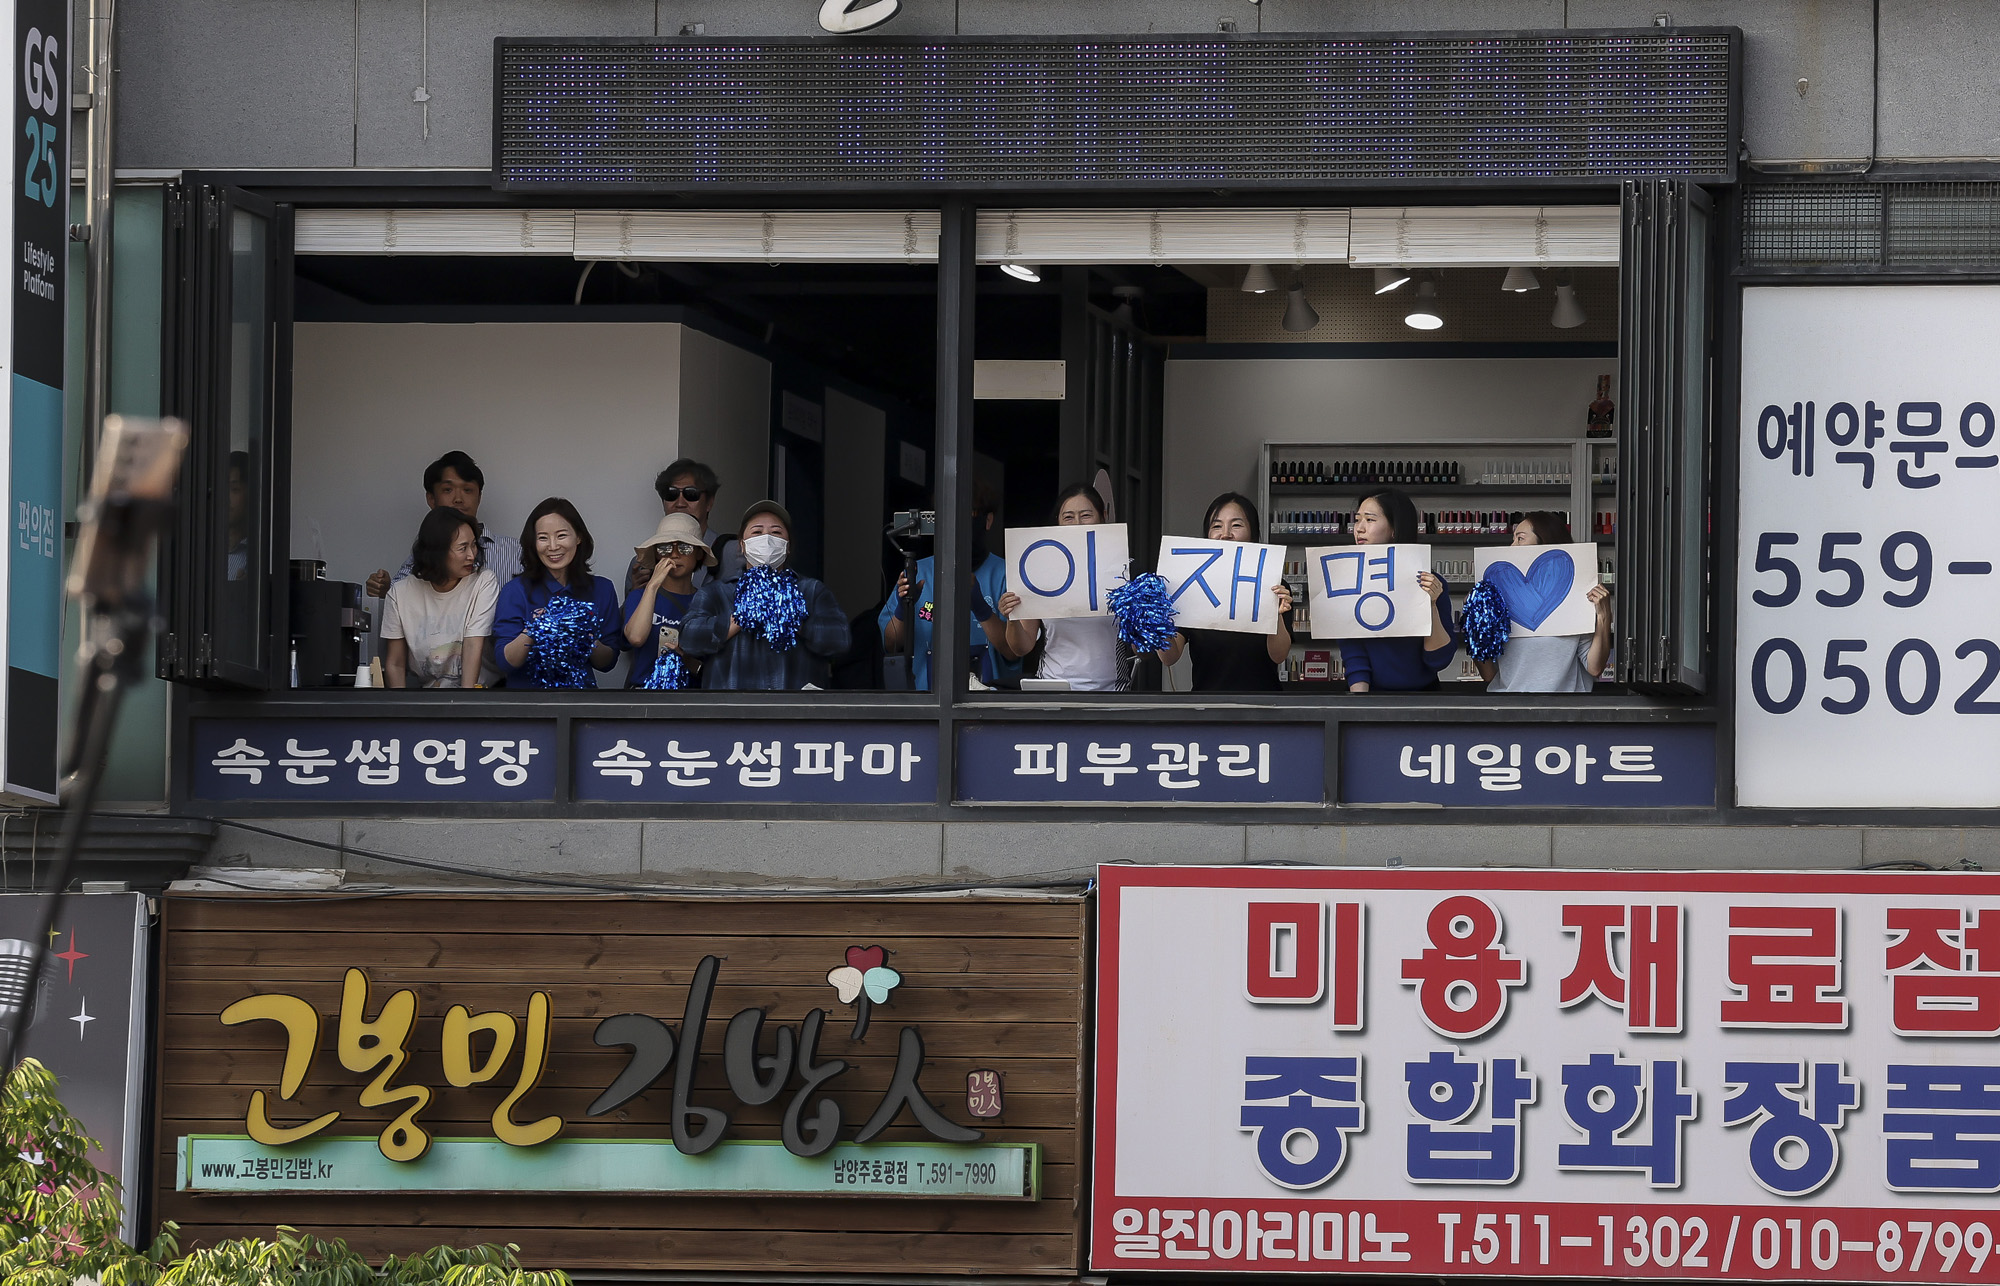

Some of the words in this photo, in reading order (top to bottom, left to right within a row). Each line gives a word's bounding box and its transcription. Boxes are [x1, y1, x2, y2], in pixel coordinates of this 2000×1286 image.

[24, 26, 59, 117] GS
[509, 46, 768, 182] 호주
[24, 115, 58, 208] 25
[23, 241, 55, 274] Lifestyle
[23, 269, 55, 301] Platform
[18, 500, 54, 557] 편의점
[1019, 530, 1099, 612] 이
[1170, 545, 1268, 624] 재
[1320, 546, 1395, 631] 명
[1752, 530, 1993, 608] 559-
[1751, 637, 2000, 716] 0502
[211, 738, 540, 786] 속눈썹연장
[592, 739, 922, 788] 속눈썹파마
[1013, 741, 1270, 789] 피부관리
[1400, 743, 1663, 792] 네일아트
[1245, 895, 2000, 1036] 미용재료점
[1239, 1050, 2000, 1194] 종합화장품
[201, 1157, 334, 1180] www.고봉민김밥.kr
[833, 1159, 908, 1185] 남양주호평점
[916, 1162, 997, 1185] T.591-7990
[1112, 1207, 1412, 1263] 일진아리미노
[1751, 1217, 2000, 1273] 010-8799
